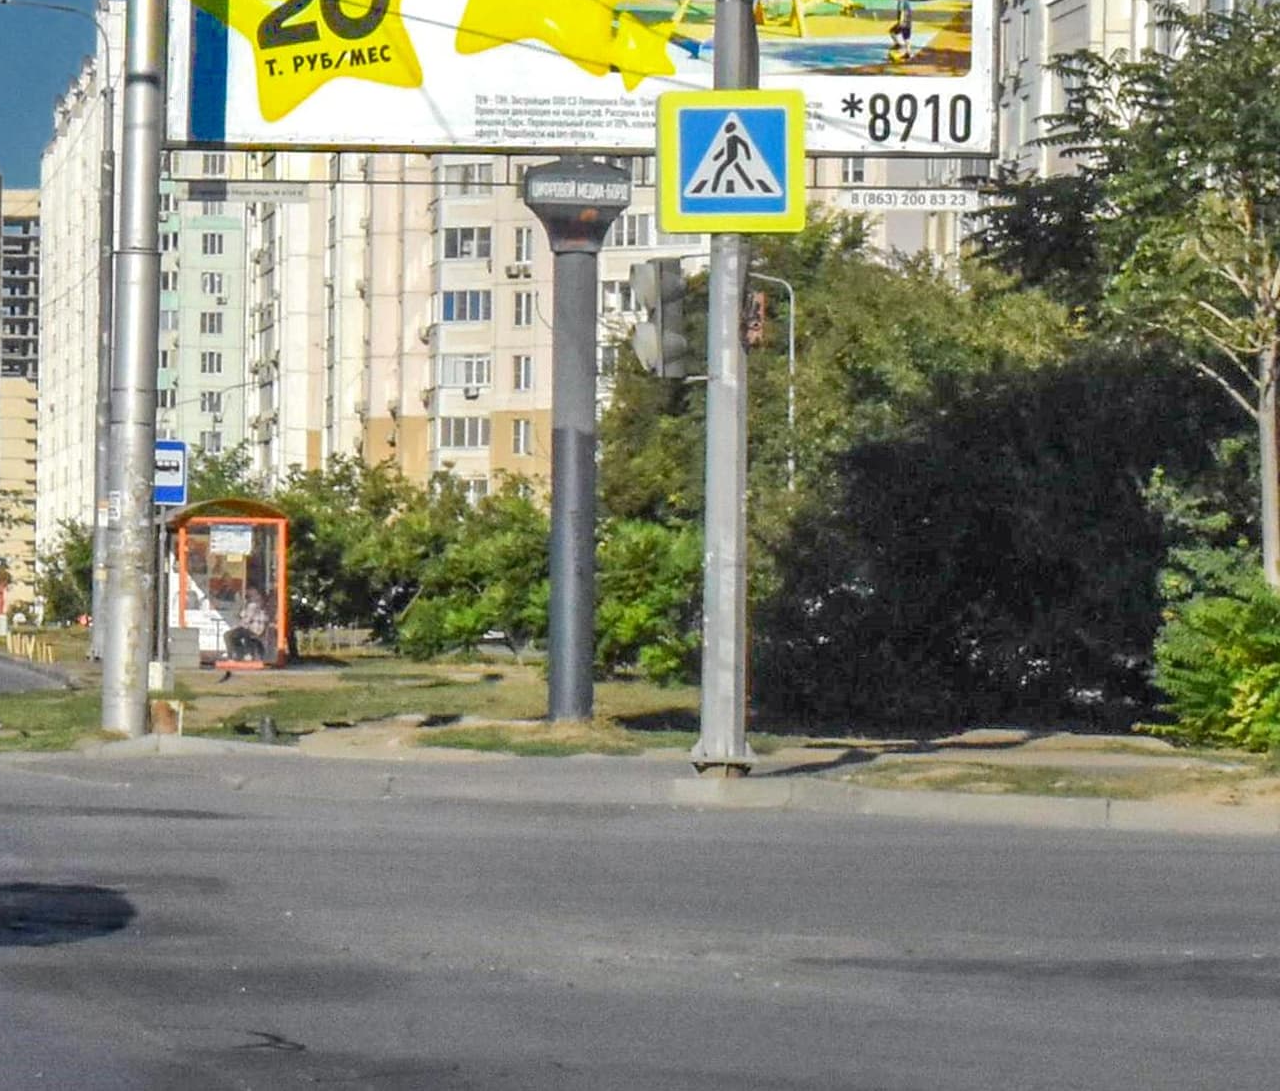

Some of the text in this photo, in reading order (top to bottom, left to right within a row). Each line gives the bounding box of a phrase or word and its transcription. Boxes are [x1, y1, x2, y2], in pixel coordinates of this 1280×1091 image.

[265, 44, 392, 77] Т. РУБ/МЕС
[851, 193, 966, 207] 8 (863) 200 83 23
